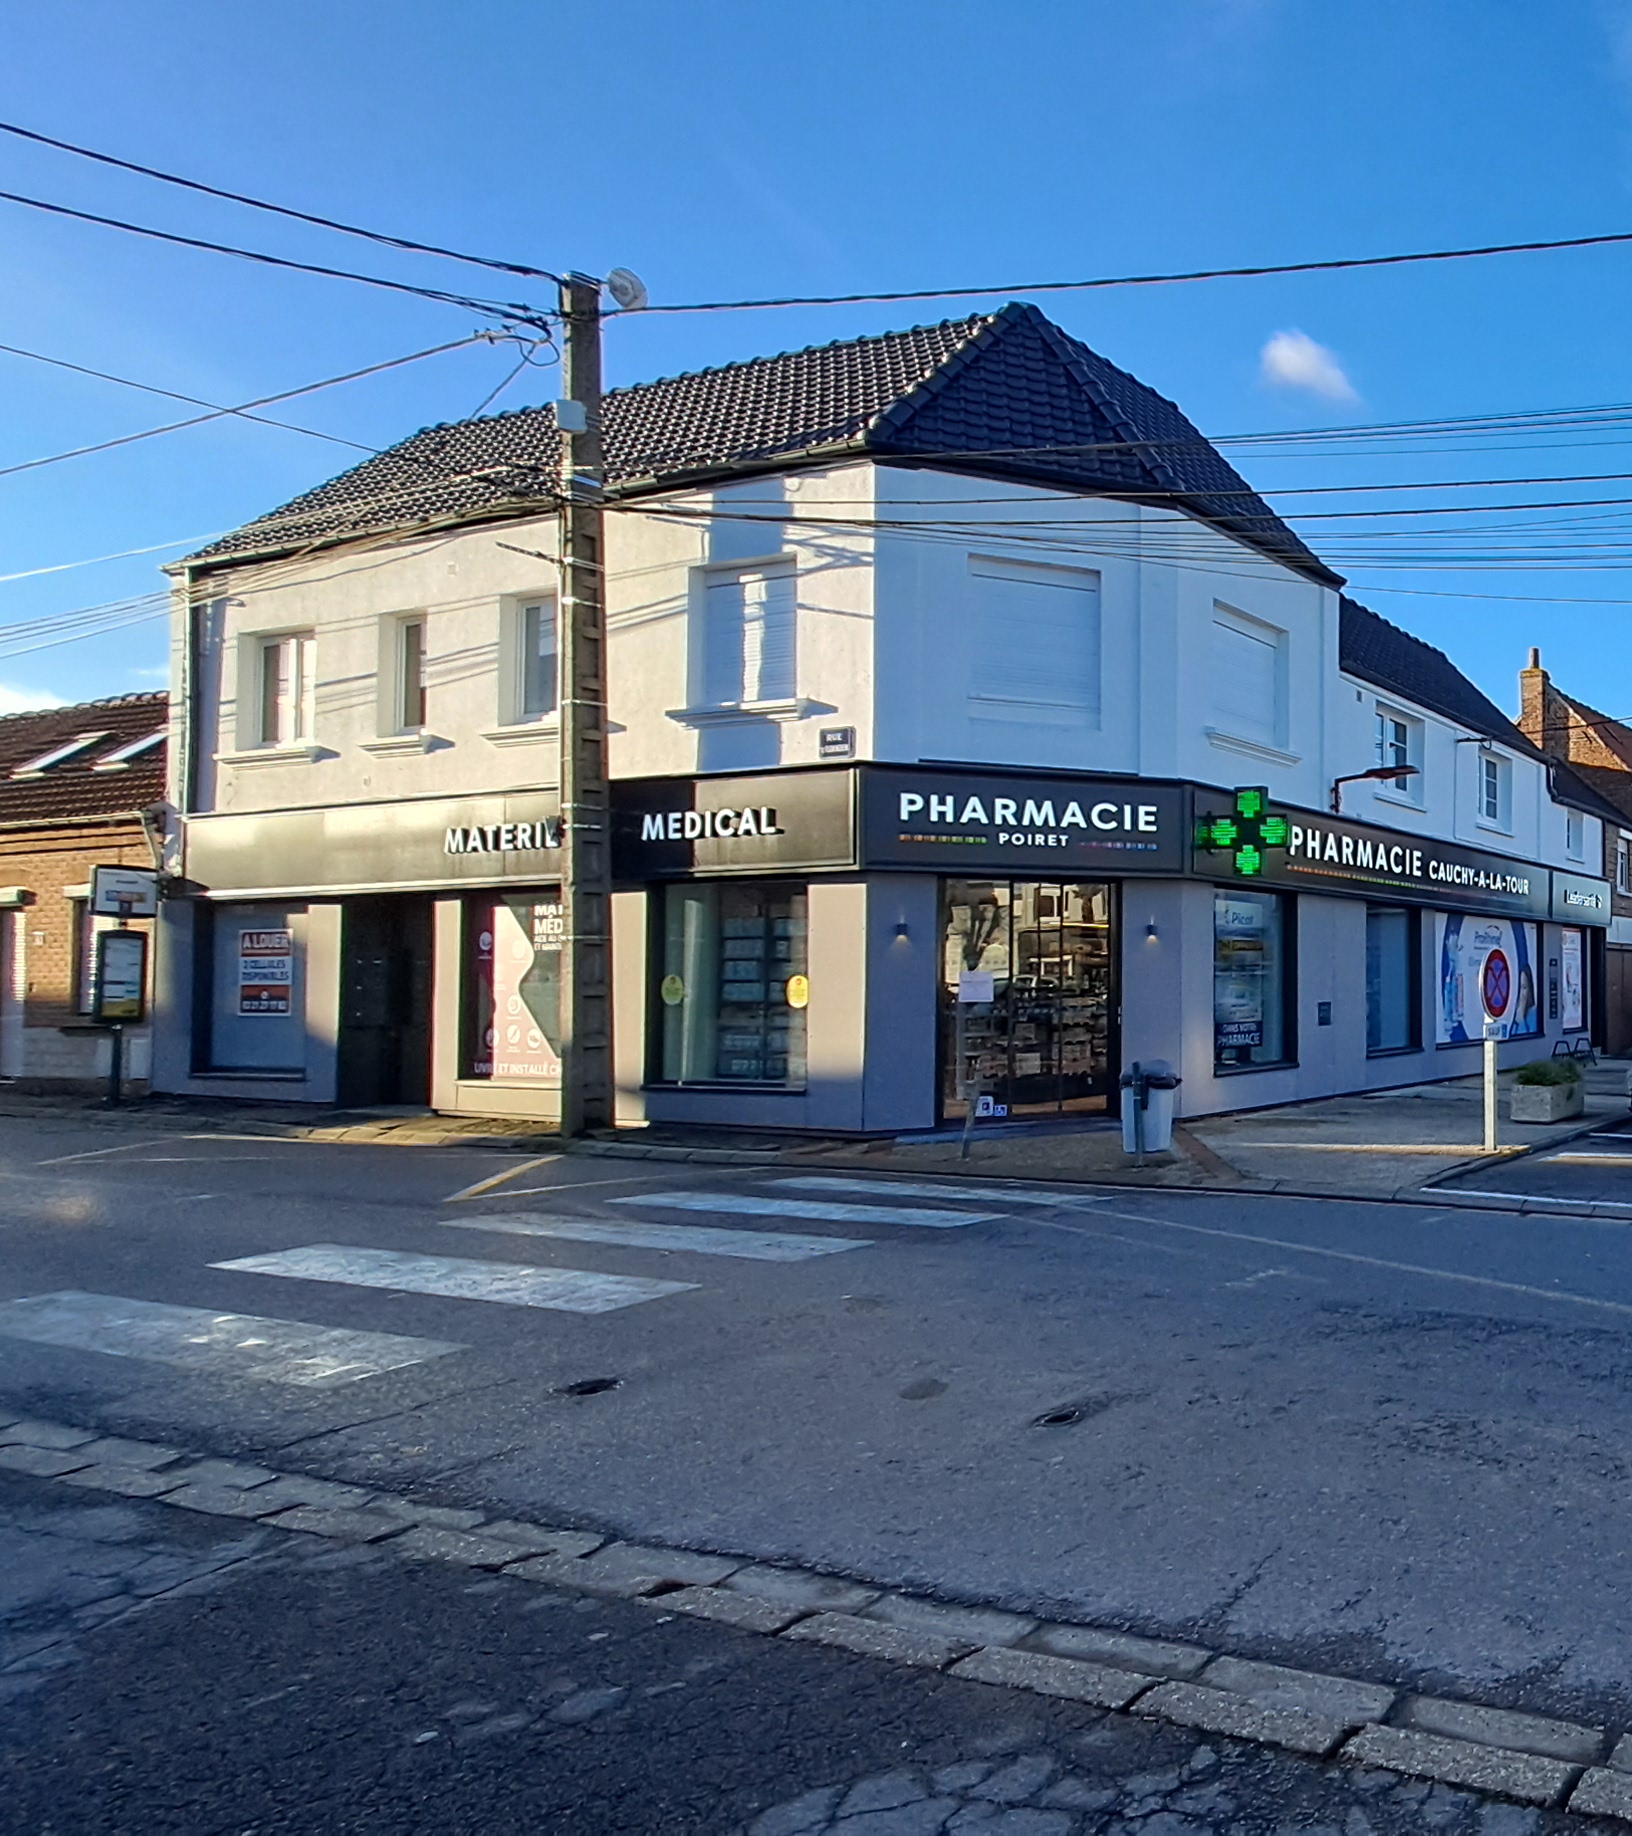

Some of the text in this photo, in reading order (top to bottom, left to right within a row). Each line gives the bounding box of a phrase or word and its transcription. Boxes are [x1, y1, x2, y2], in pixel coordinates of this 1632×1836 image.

[641, 807, 776, 841] MEDICAL
[899, 792, 1158, 832] PHARMACIE
[997, 832, 1069, 847] POIRET
[1289, 825, 1530, 895] PHARMACIE CAUCHY-A-LA-TOUR
[1217, 1033, 1260, 1046] PHARMACIE
